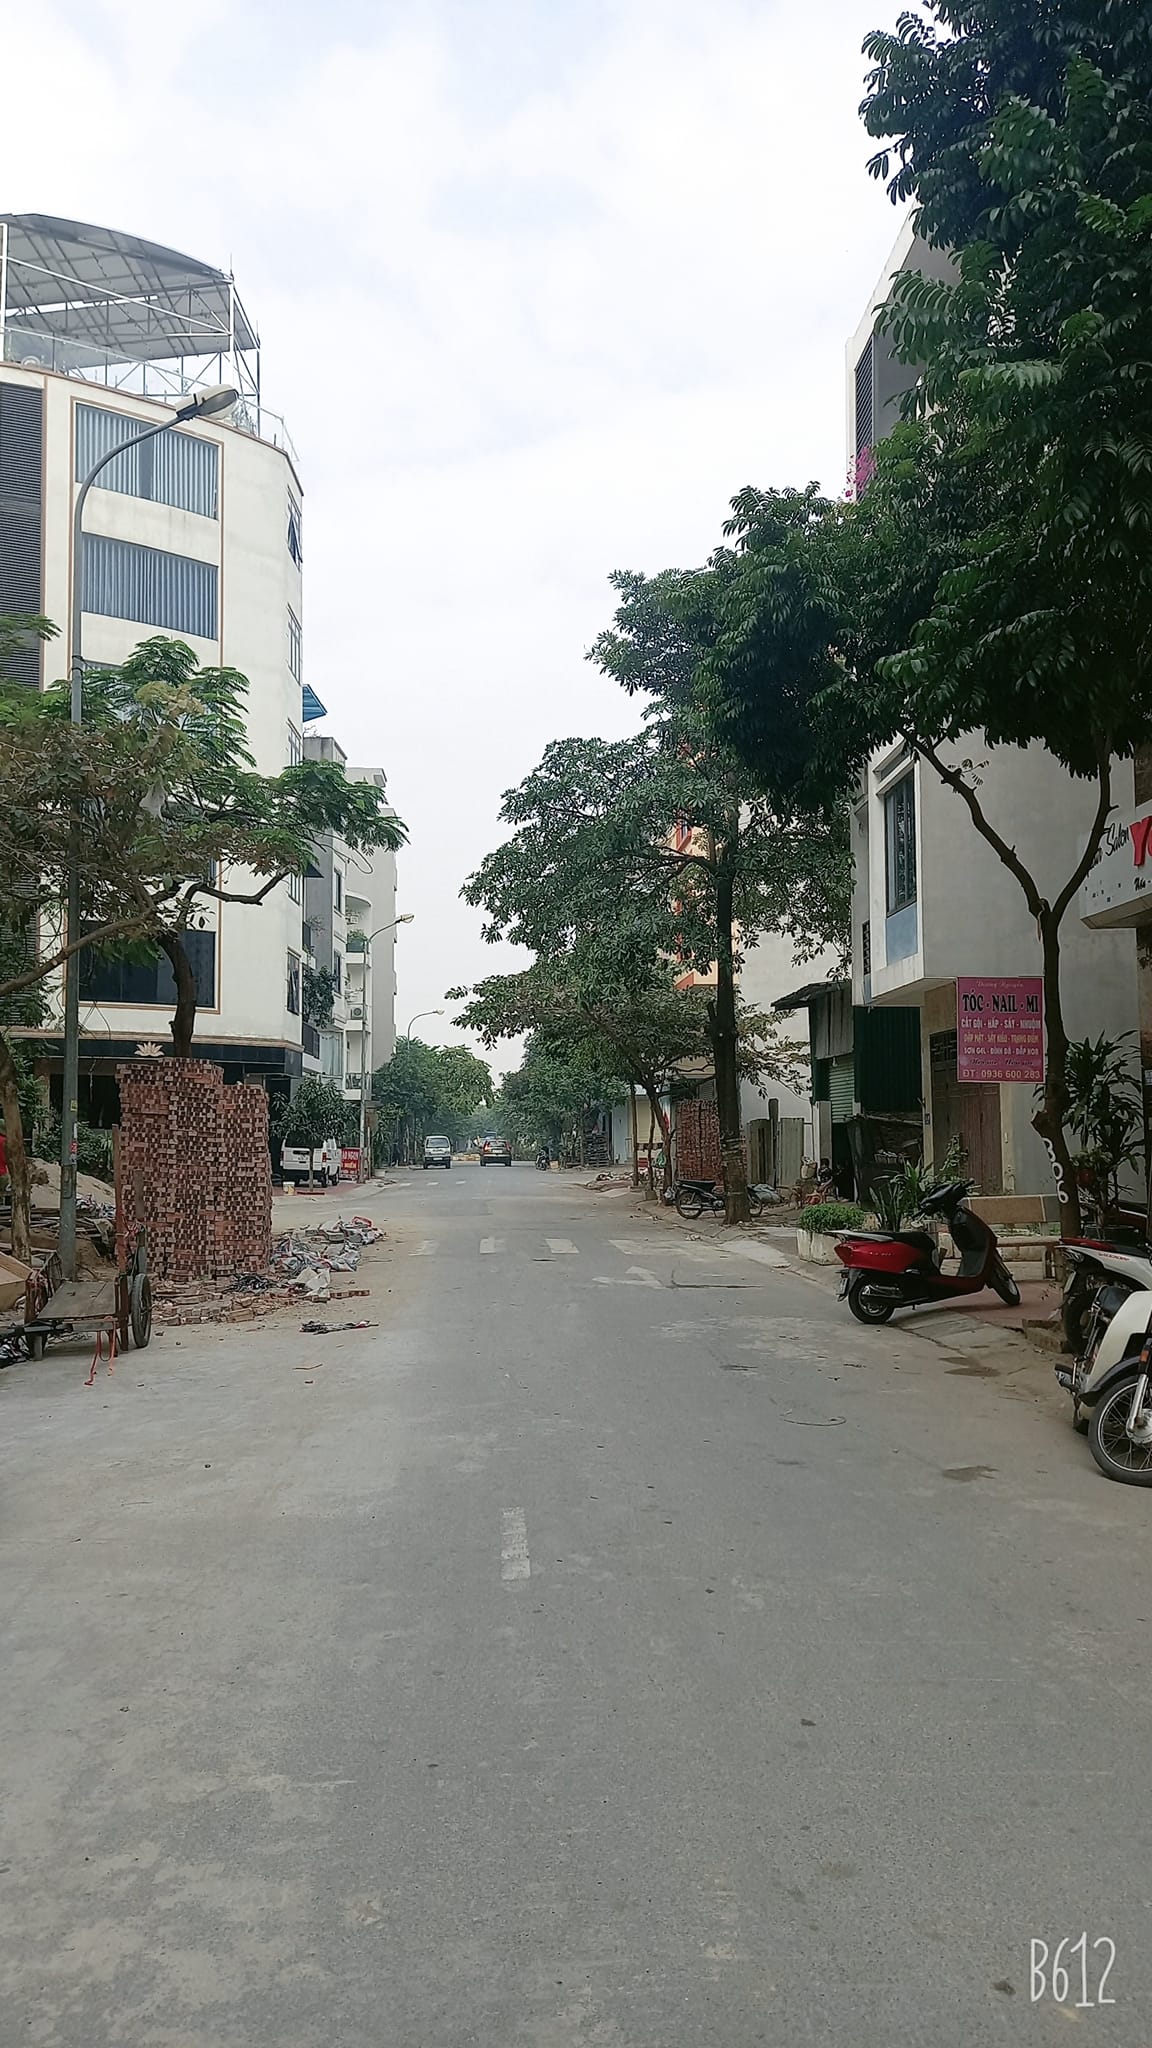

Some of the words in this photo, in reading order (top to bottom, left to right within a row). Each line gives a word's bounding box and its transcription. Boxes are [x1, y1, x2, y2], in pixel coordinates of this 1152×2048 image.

[962, 988, 984, 1012] TÓC
[991, 994, 1018, 1013] NAIL
[1026, 994, 1039, 1013] MI
[981, 1069, 1003, 1079] 0936
[1024, 1070, 1041, 1079] 283
